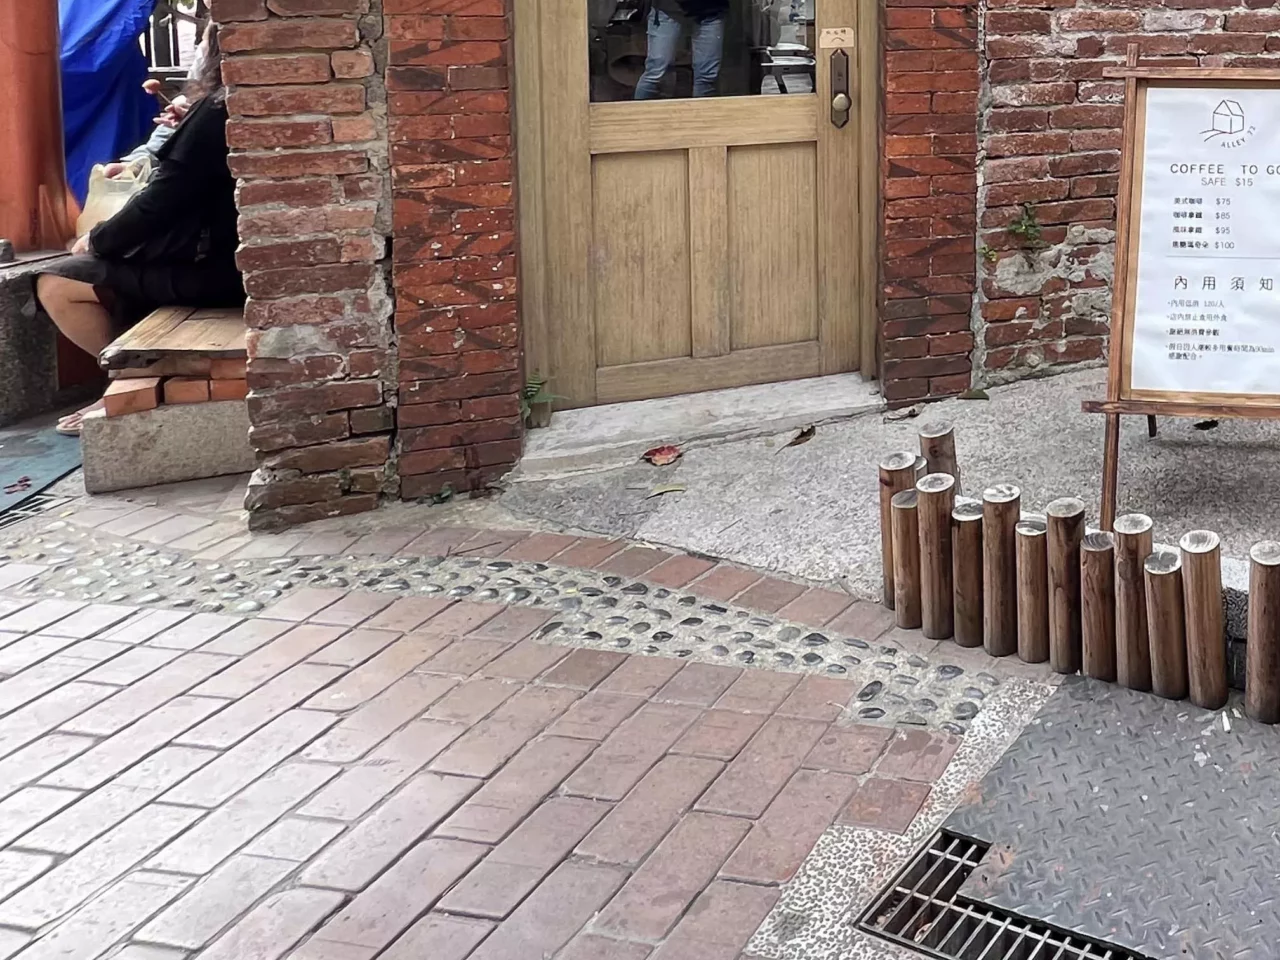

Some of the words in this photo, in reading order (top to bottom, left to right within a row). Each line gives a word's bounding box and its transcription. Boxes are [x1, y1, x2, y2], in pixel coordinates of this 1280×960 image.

[1220, 137, 1246, 149] ALLEY
[1170, 163, 1225, 174] COFFEE
[1240, 164, 1258, 174] TO
[1201, 177, 1226, 187] SAFE
[1235, 178, 1253, 187] $15
[1216, 197, 1231, 206] $75
[1215, 211, 1231, 220] $85
[1215, 226, 1231, 235] $95
[1215, 241, 1235, 250] $100
